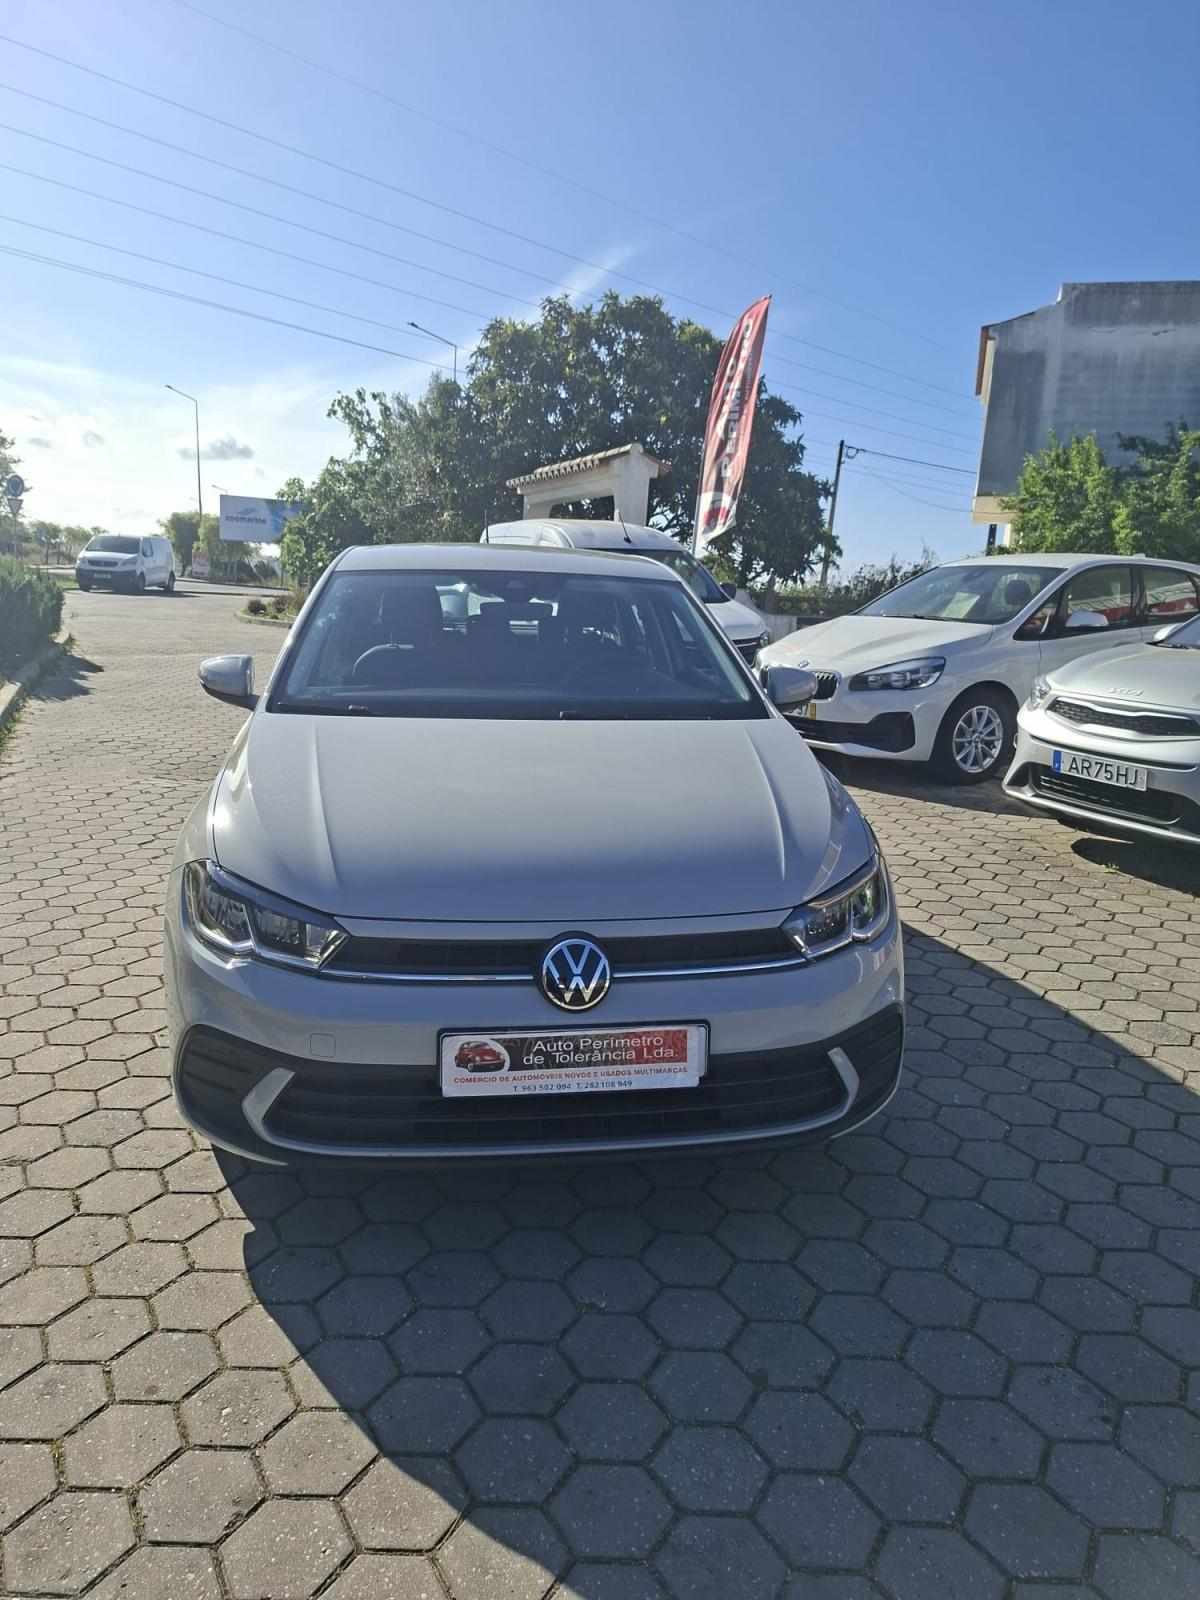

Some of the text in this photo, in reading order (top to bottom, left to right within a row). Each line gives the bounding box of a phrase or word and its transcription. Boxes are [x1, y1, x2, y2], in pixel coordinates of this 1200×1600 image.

[532, 1040, 574, 1052] Auto
[523, 1046, 679, 1065] de Tolerância Lda.
[565, 1072, 591, 1080] NOVOS
[600, 1070, 631, 1078] USADOS
[633, 1067, 688, 1077] MULTIMARCAS
